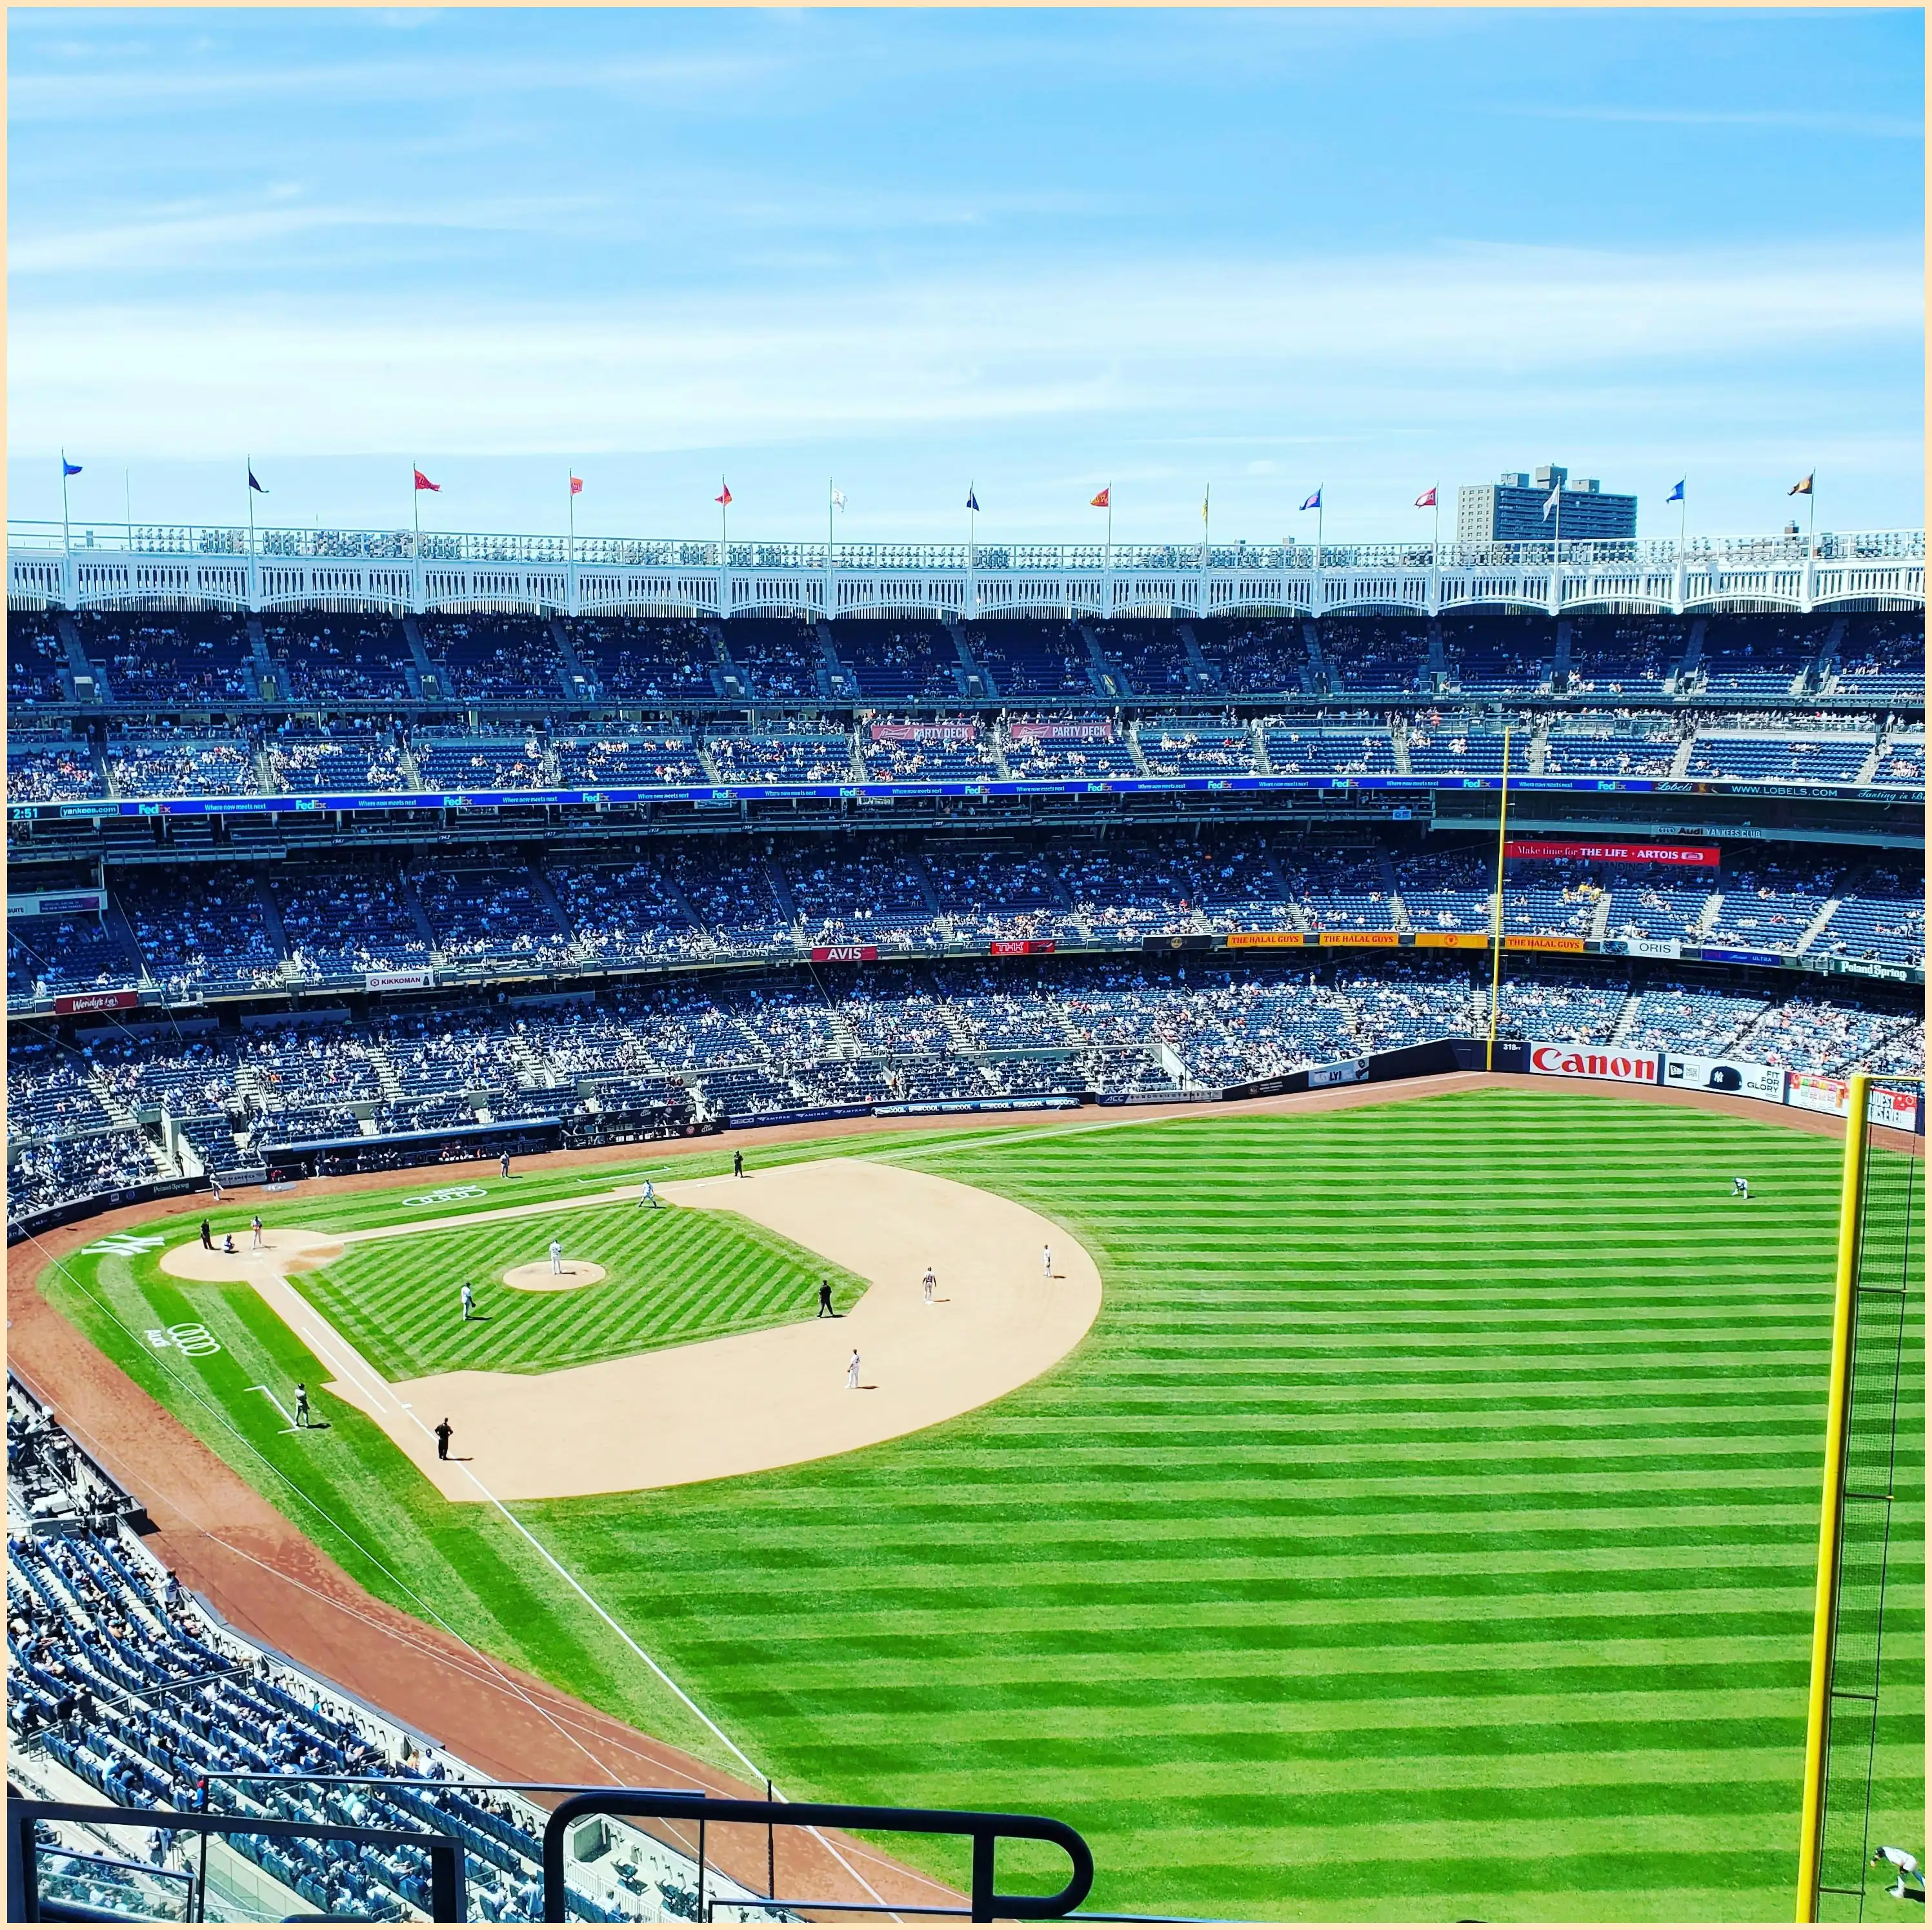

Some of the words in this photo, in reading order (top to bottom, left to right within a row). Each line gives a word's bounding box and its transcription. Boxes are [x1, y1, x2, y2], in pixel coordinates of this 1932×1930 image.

[913, 727, 942, 738] PARTY
[945, 727, 969, 738] DECK
[1052, 726, 1080, 737] PARTY
[1082, 725, 1106, 736] DECK
[1087, 783, 1112, 792] FedEx
[1208, 780, 1232, 789] FedEx
[1332, 778, 1359, 787] FedEx
[1464, 779, 1491, 788] FedEx
[1598, 781, 1626, 790] FedEx
[712, 789, 738, 799] FedEx
[840, 787, 865, 796] FedEx
[965, 785, 990, 794] FedEx
[1731, 785, 1838, 796] WWW.LOBELS.COM
[444, 796, 473, 806] FedEx
[583, 792, 609, 802] FedEx
[139, 803, 170, 814] FedEx
[296, 799, 326, 810] FedEx
[14, 808, 37, 819] 2:51
[63, 806, 116, 817] yankees.com
[1678, 827, 1704, 836] Audi
[1706, 829, 1740, 837] YANKEES
[1518, 845, 1542, 854] Make
[1543, 847, 1563, 855] time
[1565, 847, 1578, 856] for
[1580, 848, 1602, 857] THE
[1605, 849, 1628, 858] LIFE
[1637, 850, 1679, 859] ARTOIS
[996, 941, 1024, 952] THK
[1558, 941, 1580, 949] GUYS
[1639, 943, 1671, 953] ORIS
[827, 947, 862, 960] AVIS
[1841, 961, 1873, 974] Poland
[1874, 965, 1907, 981] Spring
[381, 976, 421, 985] KIKKOMAN
[72, 996, 103, 1011] Wendy's
[1533, 1047, 1655, 1080] Canon
[1761, 1077, 1779, 1085] FOR
[1747, 1081, 1779, 1092] GLORY
